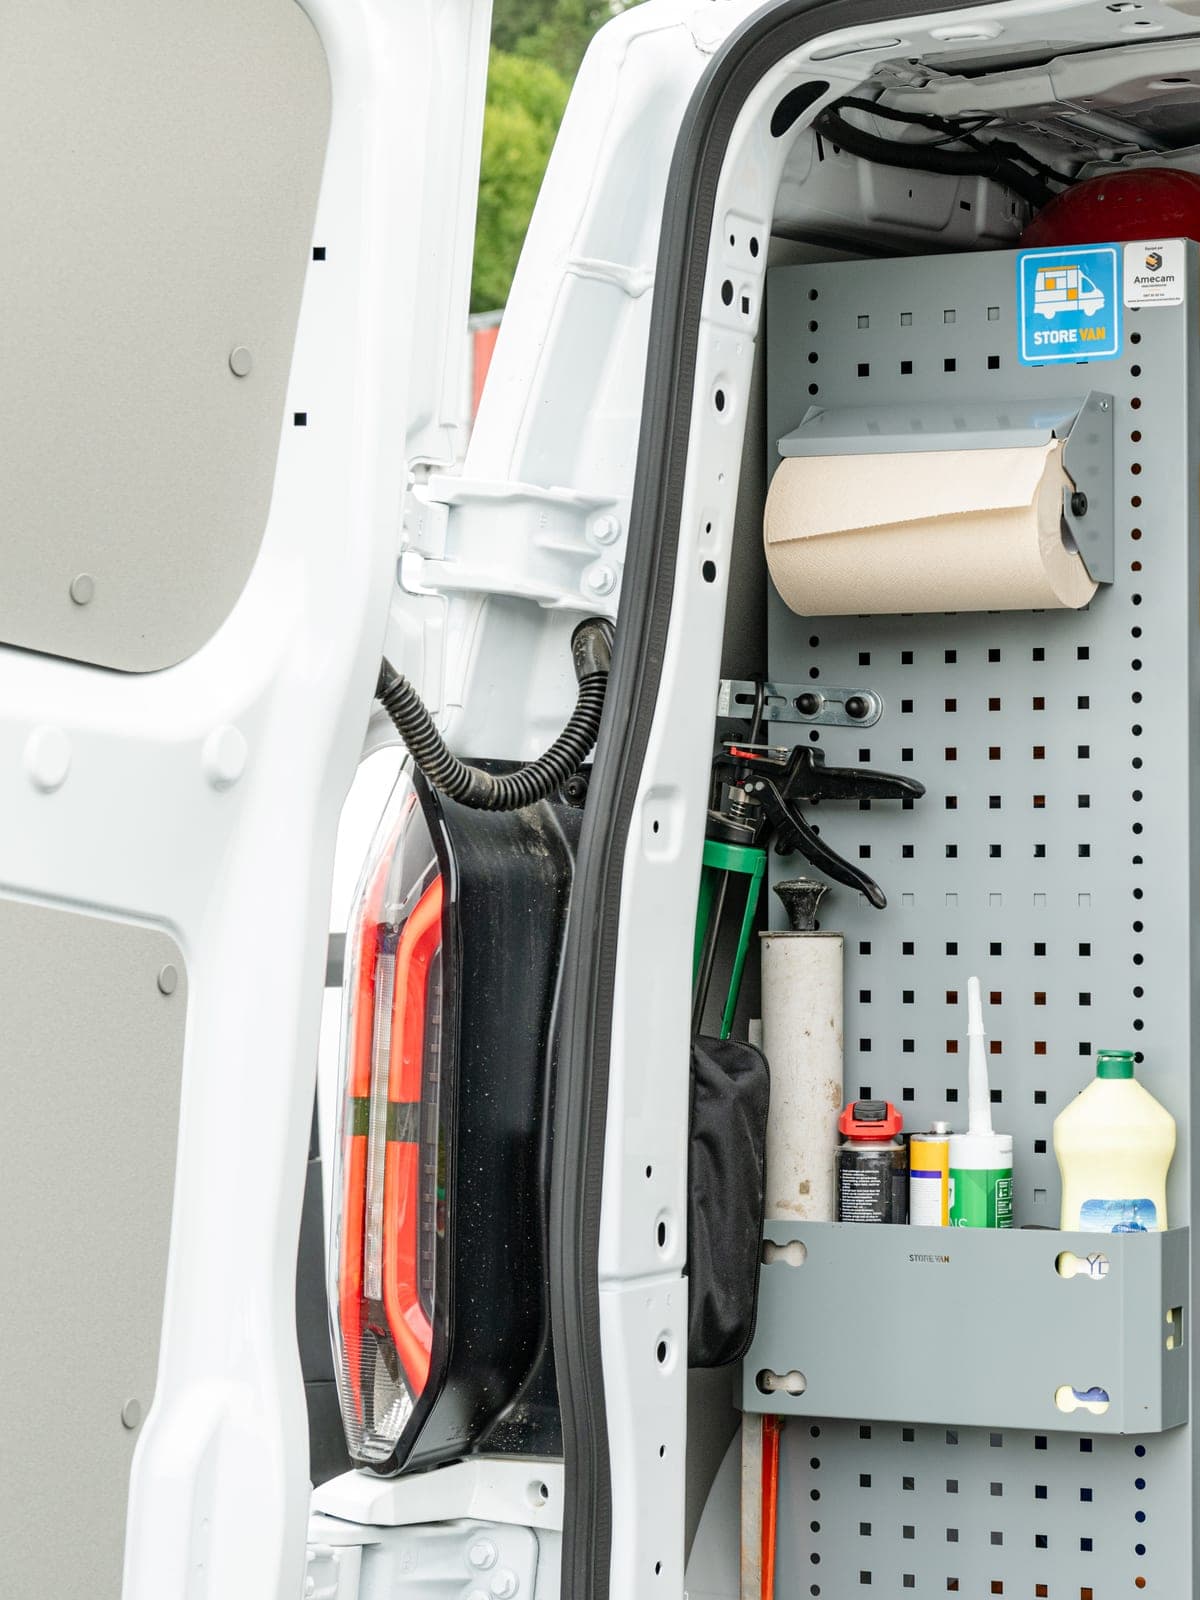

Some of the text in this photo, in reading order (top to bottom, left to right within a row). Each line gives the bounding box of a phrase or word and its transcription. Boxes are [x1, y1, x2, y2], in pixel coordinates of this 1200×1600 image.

[1133, 275, 1175, 285] Amecam
[1033, 326, 1106, 346] STORE VAN
